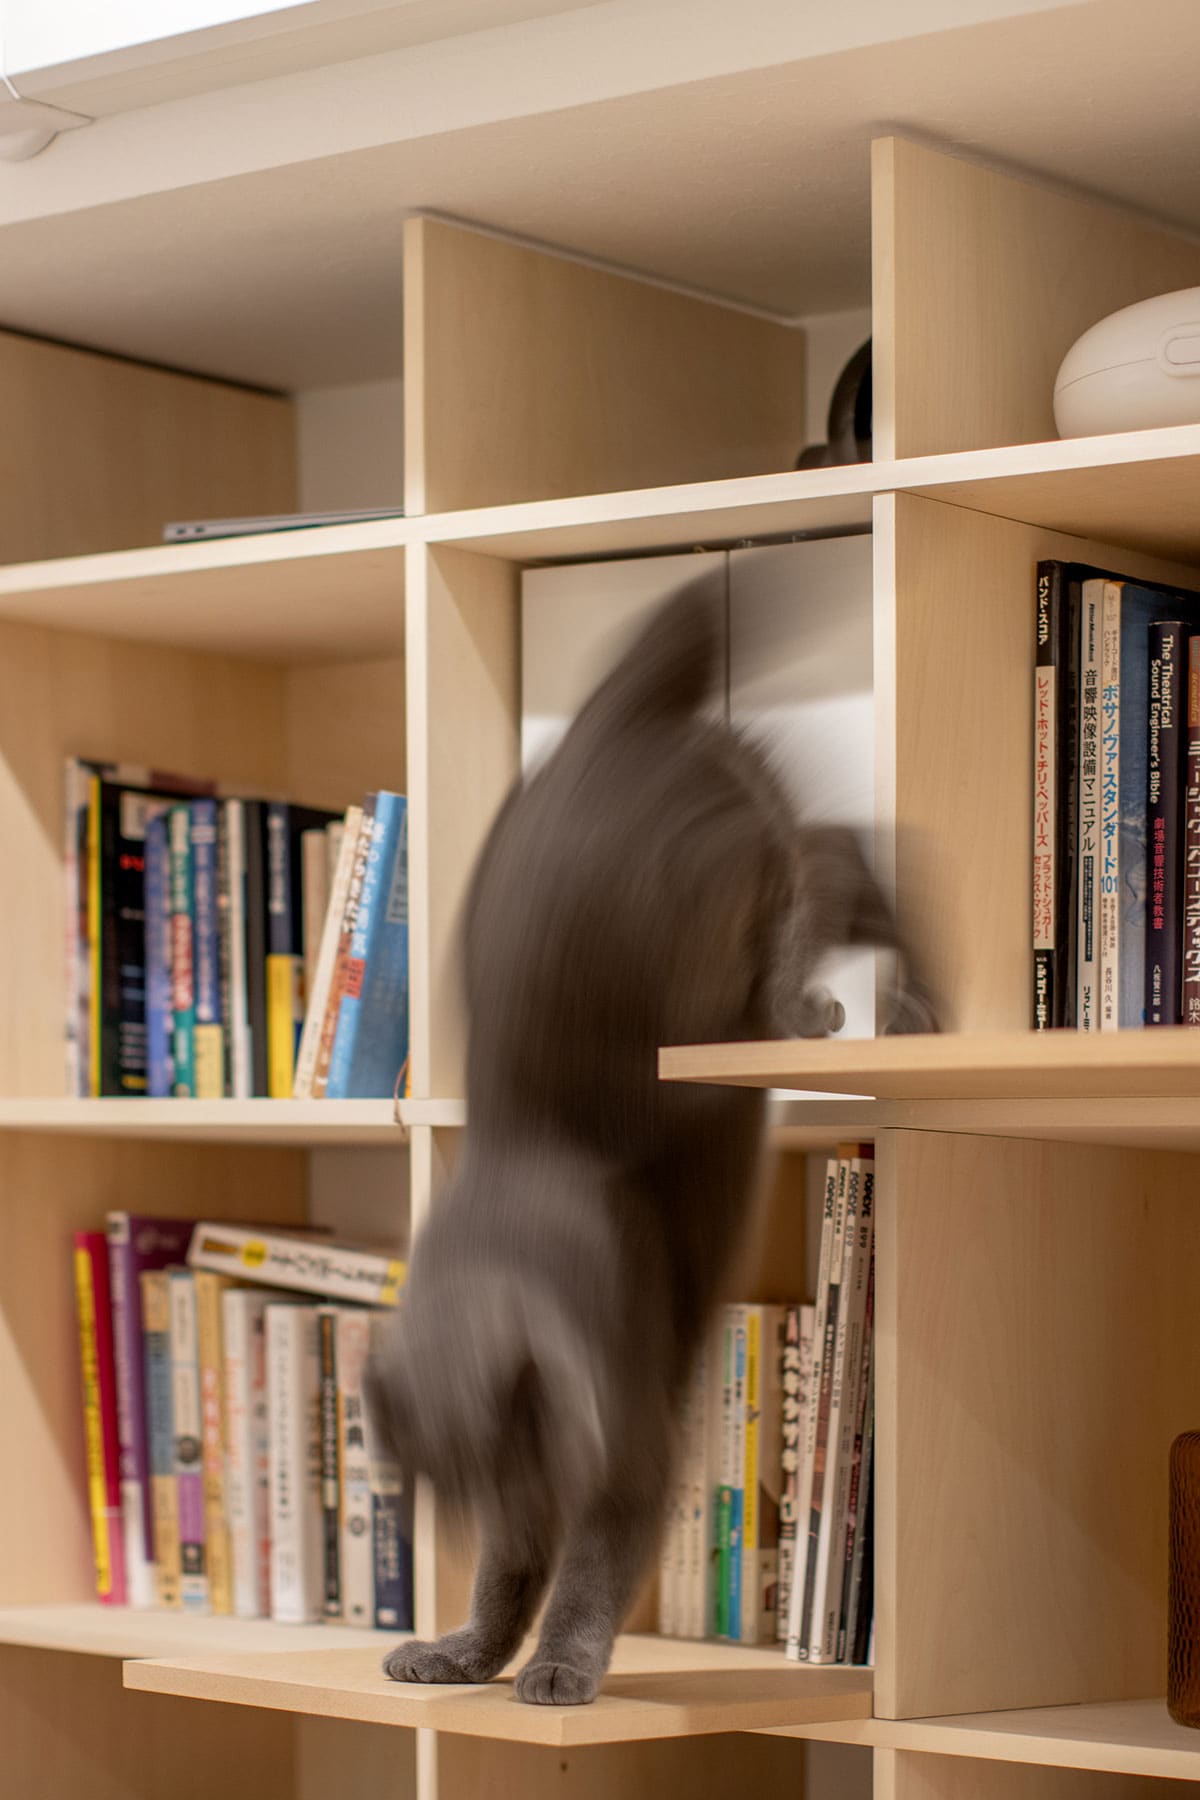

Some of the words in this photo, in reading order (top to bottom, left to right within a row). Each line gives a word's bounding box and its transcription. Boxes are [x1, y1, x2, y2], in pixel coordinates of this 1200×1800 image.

[1038, 576, 1049, 645] バンド・スコア
[1162, 635, 1174, 660] The
[1151, 659, 1161, 699] Sound
[1161, 663, 1174, 728] Theatrical
[1082, 669, 1098, 852] 音響映像設備マニュアル
[1149, 702, 1161, 769] Engineer's
[1150, 771, 1161, 804] Bible
[862, 1172, 875, 1218] POPEYE
